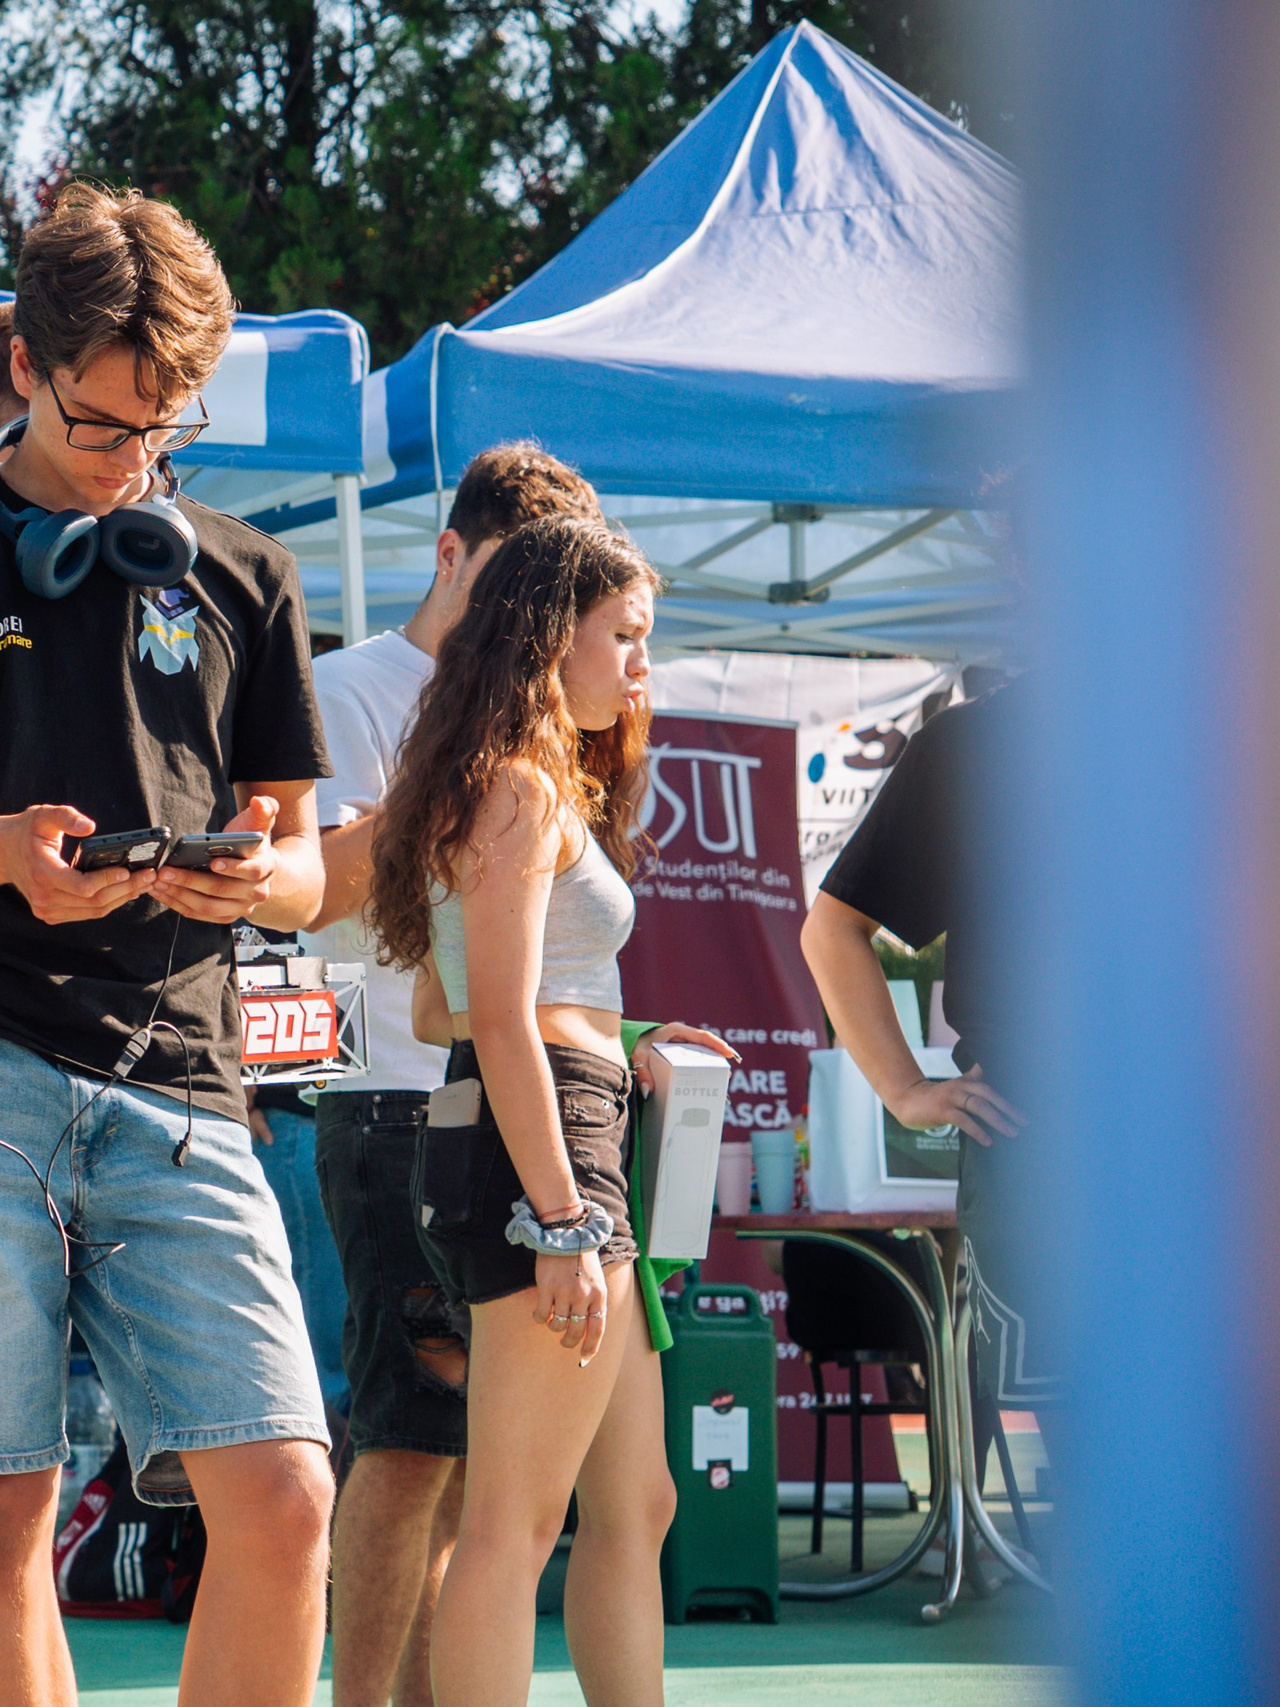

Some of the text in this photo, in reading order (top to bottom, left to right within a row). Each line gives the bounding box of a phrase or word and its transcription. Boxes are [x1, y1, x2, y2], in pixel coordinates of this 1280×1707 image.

[761, 866, 791, 889] din
[656, 881, 693, 901] Vest
[695, 883, 725, 901] din
[240, 999, 333, 1055] 205
[724, 1028, 768, 1044] care
[674, 1087, 719, 1098] BOTTLE
[729, 1068, 788, 1095] ARE
[723, 1099, 793, 1130] ASCĂ
